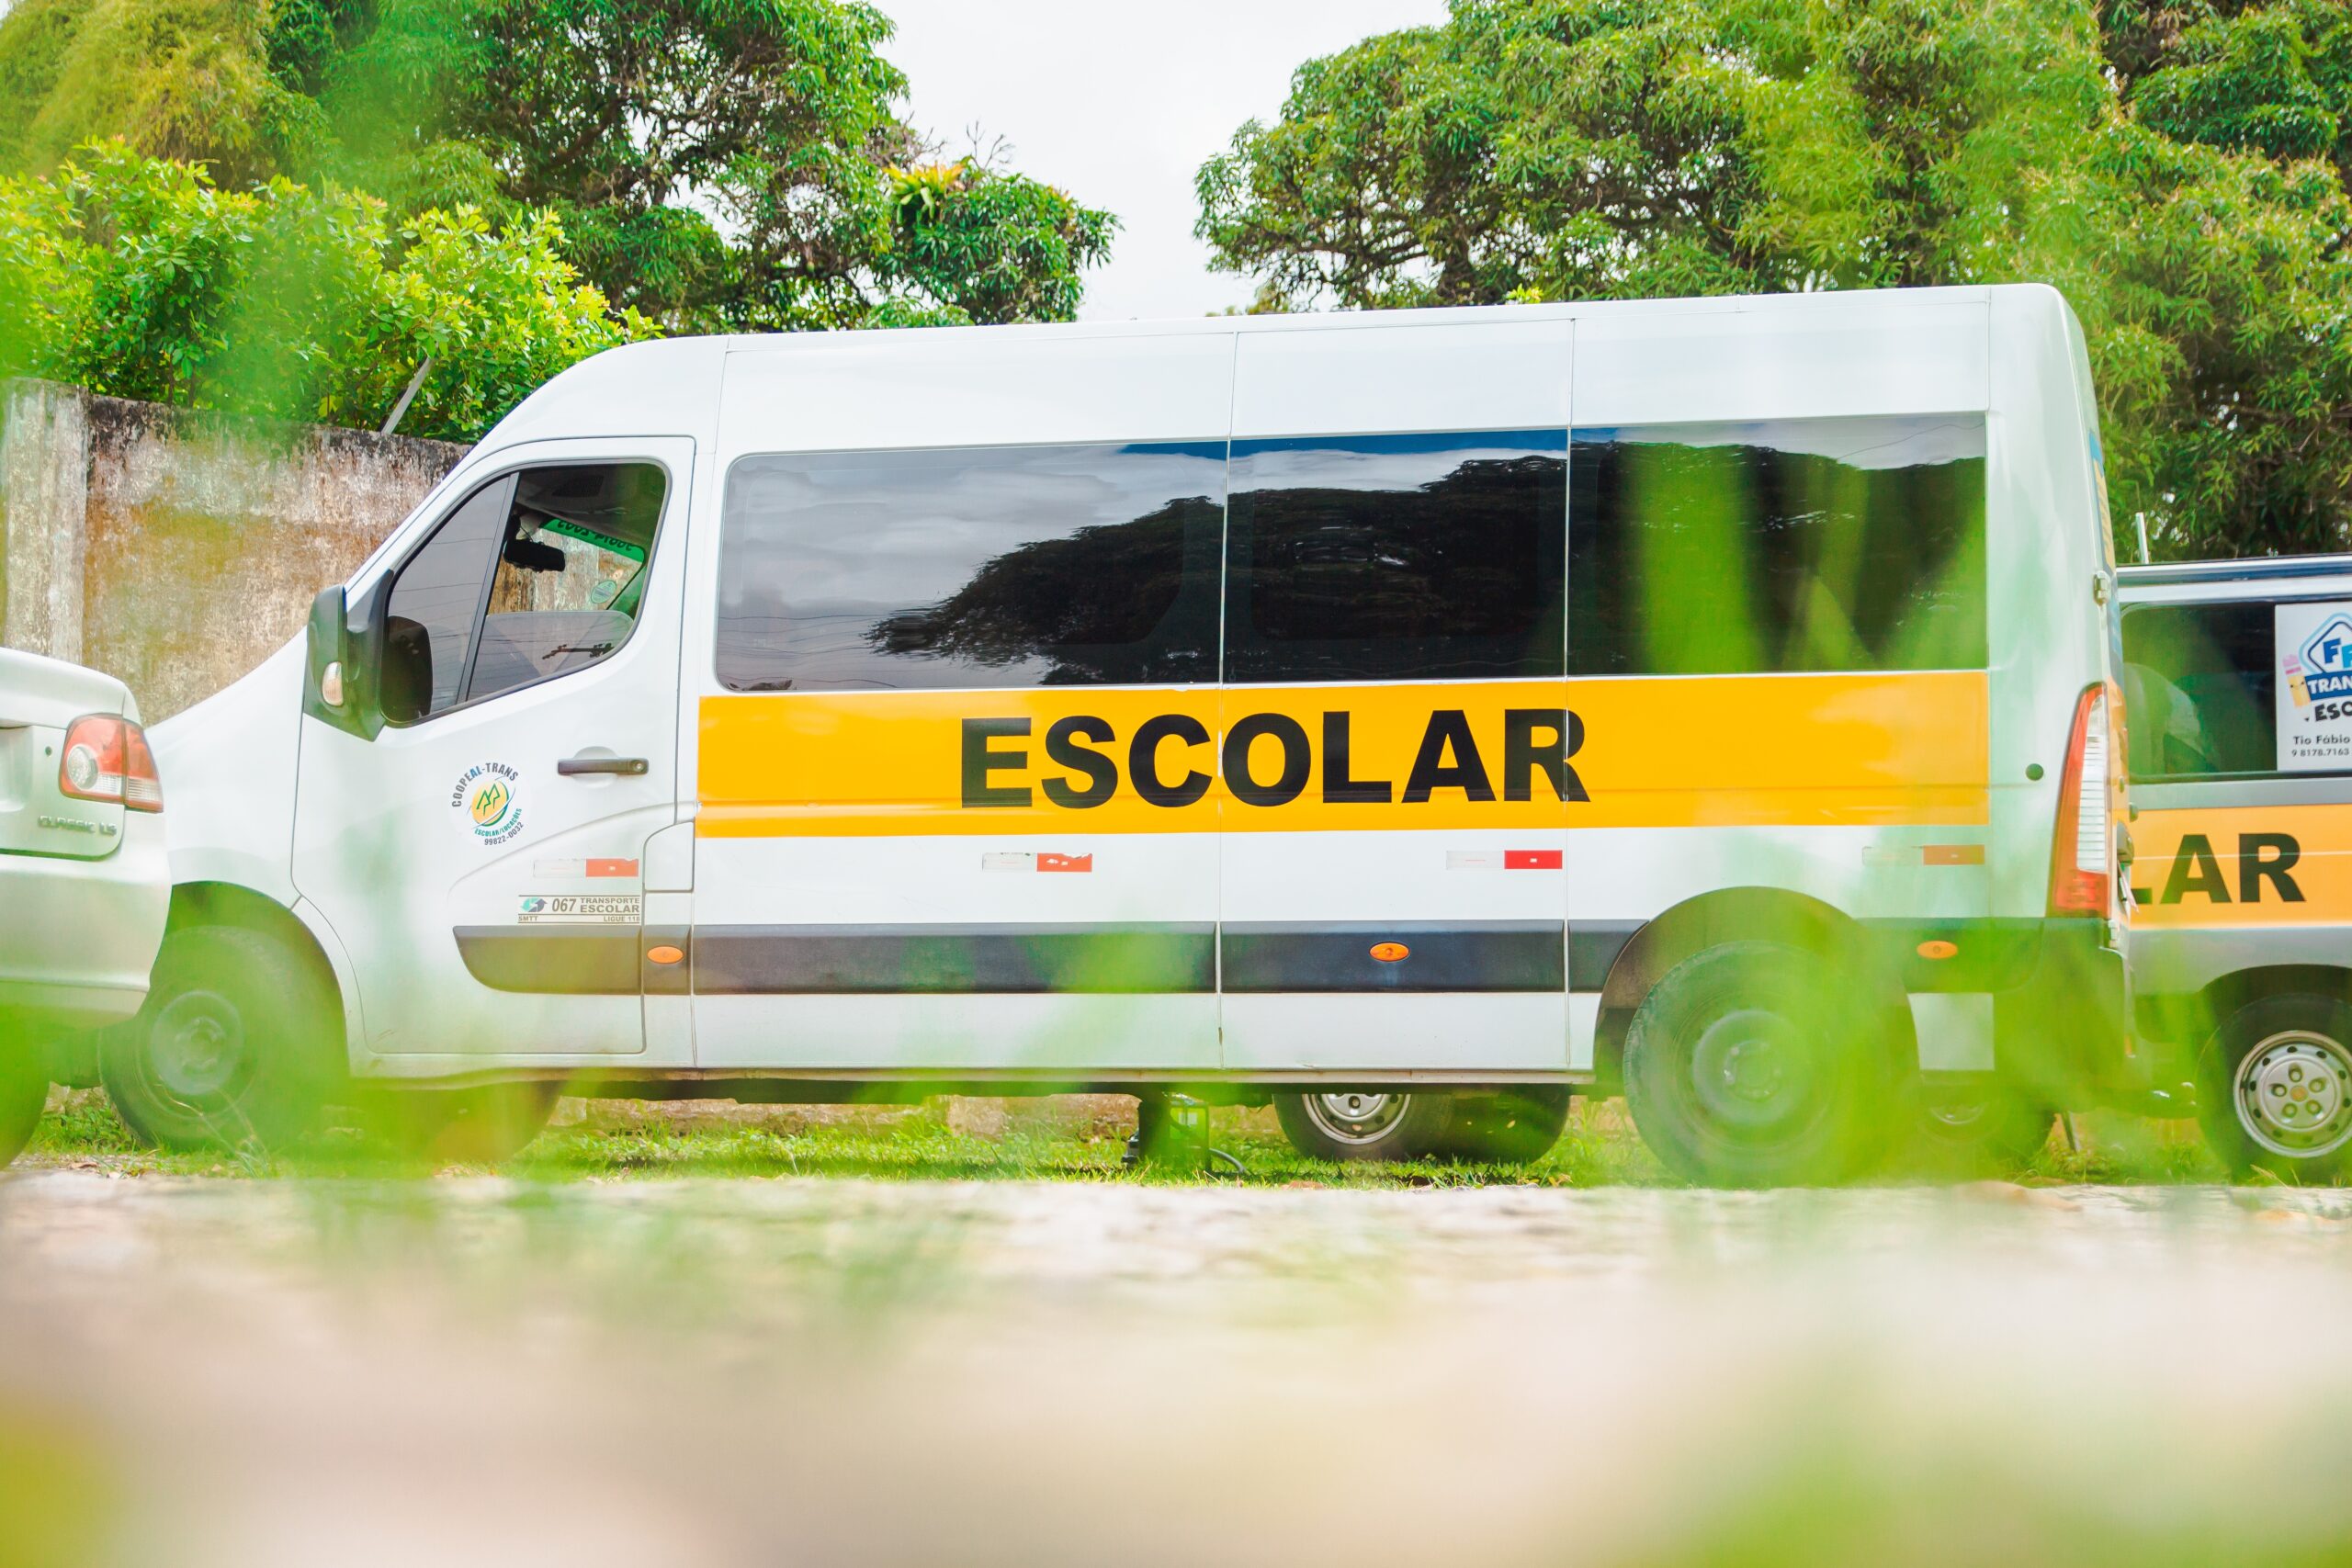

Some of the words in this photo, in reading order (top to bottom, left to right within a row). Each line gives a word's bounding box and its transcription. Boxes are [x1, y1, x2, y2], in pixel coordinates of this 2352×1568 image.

[2293, 736, 2312, 745] Tio
[2316, 734, 2351, 744] Fábio
[961, 709, 1591, 809] ESCOLAR
[451, 762, 519, 807] COOPEAL-TRANS
[484, 821, 524, 846] 99822-0032
[552, 897, 577, 912] 067
[580, 905, 640, 913] ESCOLAR
